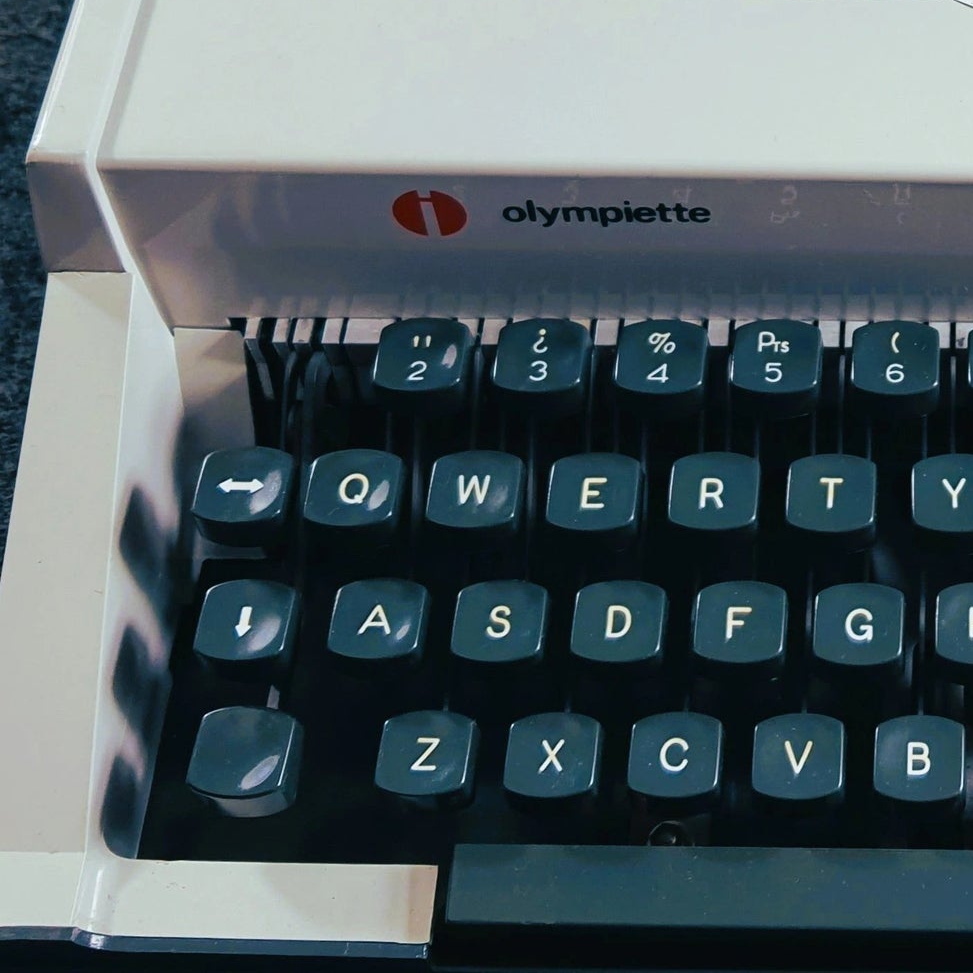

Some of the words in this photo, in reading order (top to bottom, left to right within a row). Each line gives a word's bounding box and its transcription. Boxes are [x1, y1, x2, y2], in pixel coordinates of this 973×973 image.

[502, 199, 711, 228] olympiette
[648, 332, 676, 354] %
[891, 331, 900, 354] (
[407, 360, 427, 381] 2
[529, 360, 548, 382] 3
[646, 363, 669, 383] 4
[764, 362, 783, 383] 5
[885, 363, 905, 384] 6
[338, 473, 369, 505] Q
[458, 474, 491, 505] W
[580, 477, 608, 509] E
[699, 477, 724, 509] R
[819, 477, 844, 509] T
[942, 477, 967, 509] Y
[357, 604, 391, 635] A
[486, 605, 511, 639] S
[605, 605, 632, 639] D
[725, 606, 753, 640] F
[845, 608, 873, 641] G
[410, 737, 441, 771] Z
[538, 739, 565, 773] X
[659, 737, 689, 772] C
[784, 740, 813, 775] V
[906, 741, 931, 776] B
